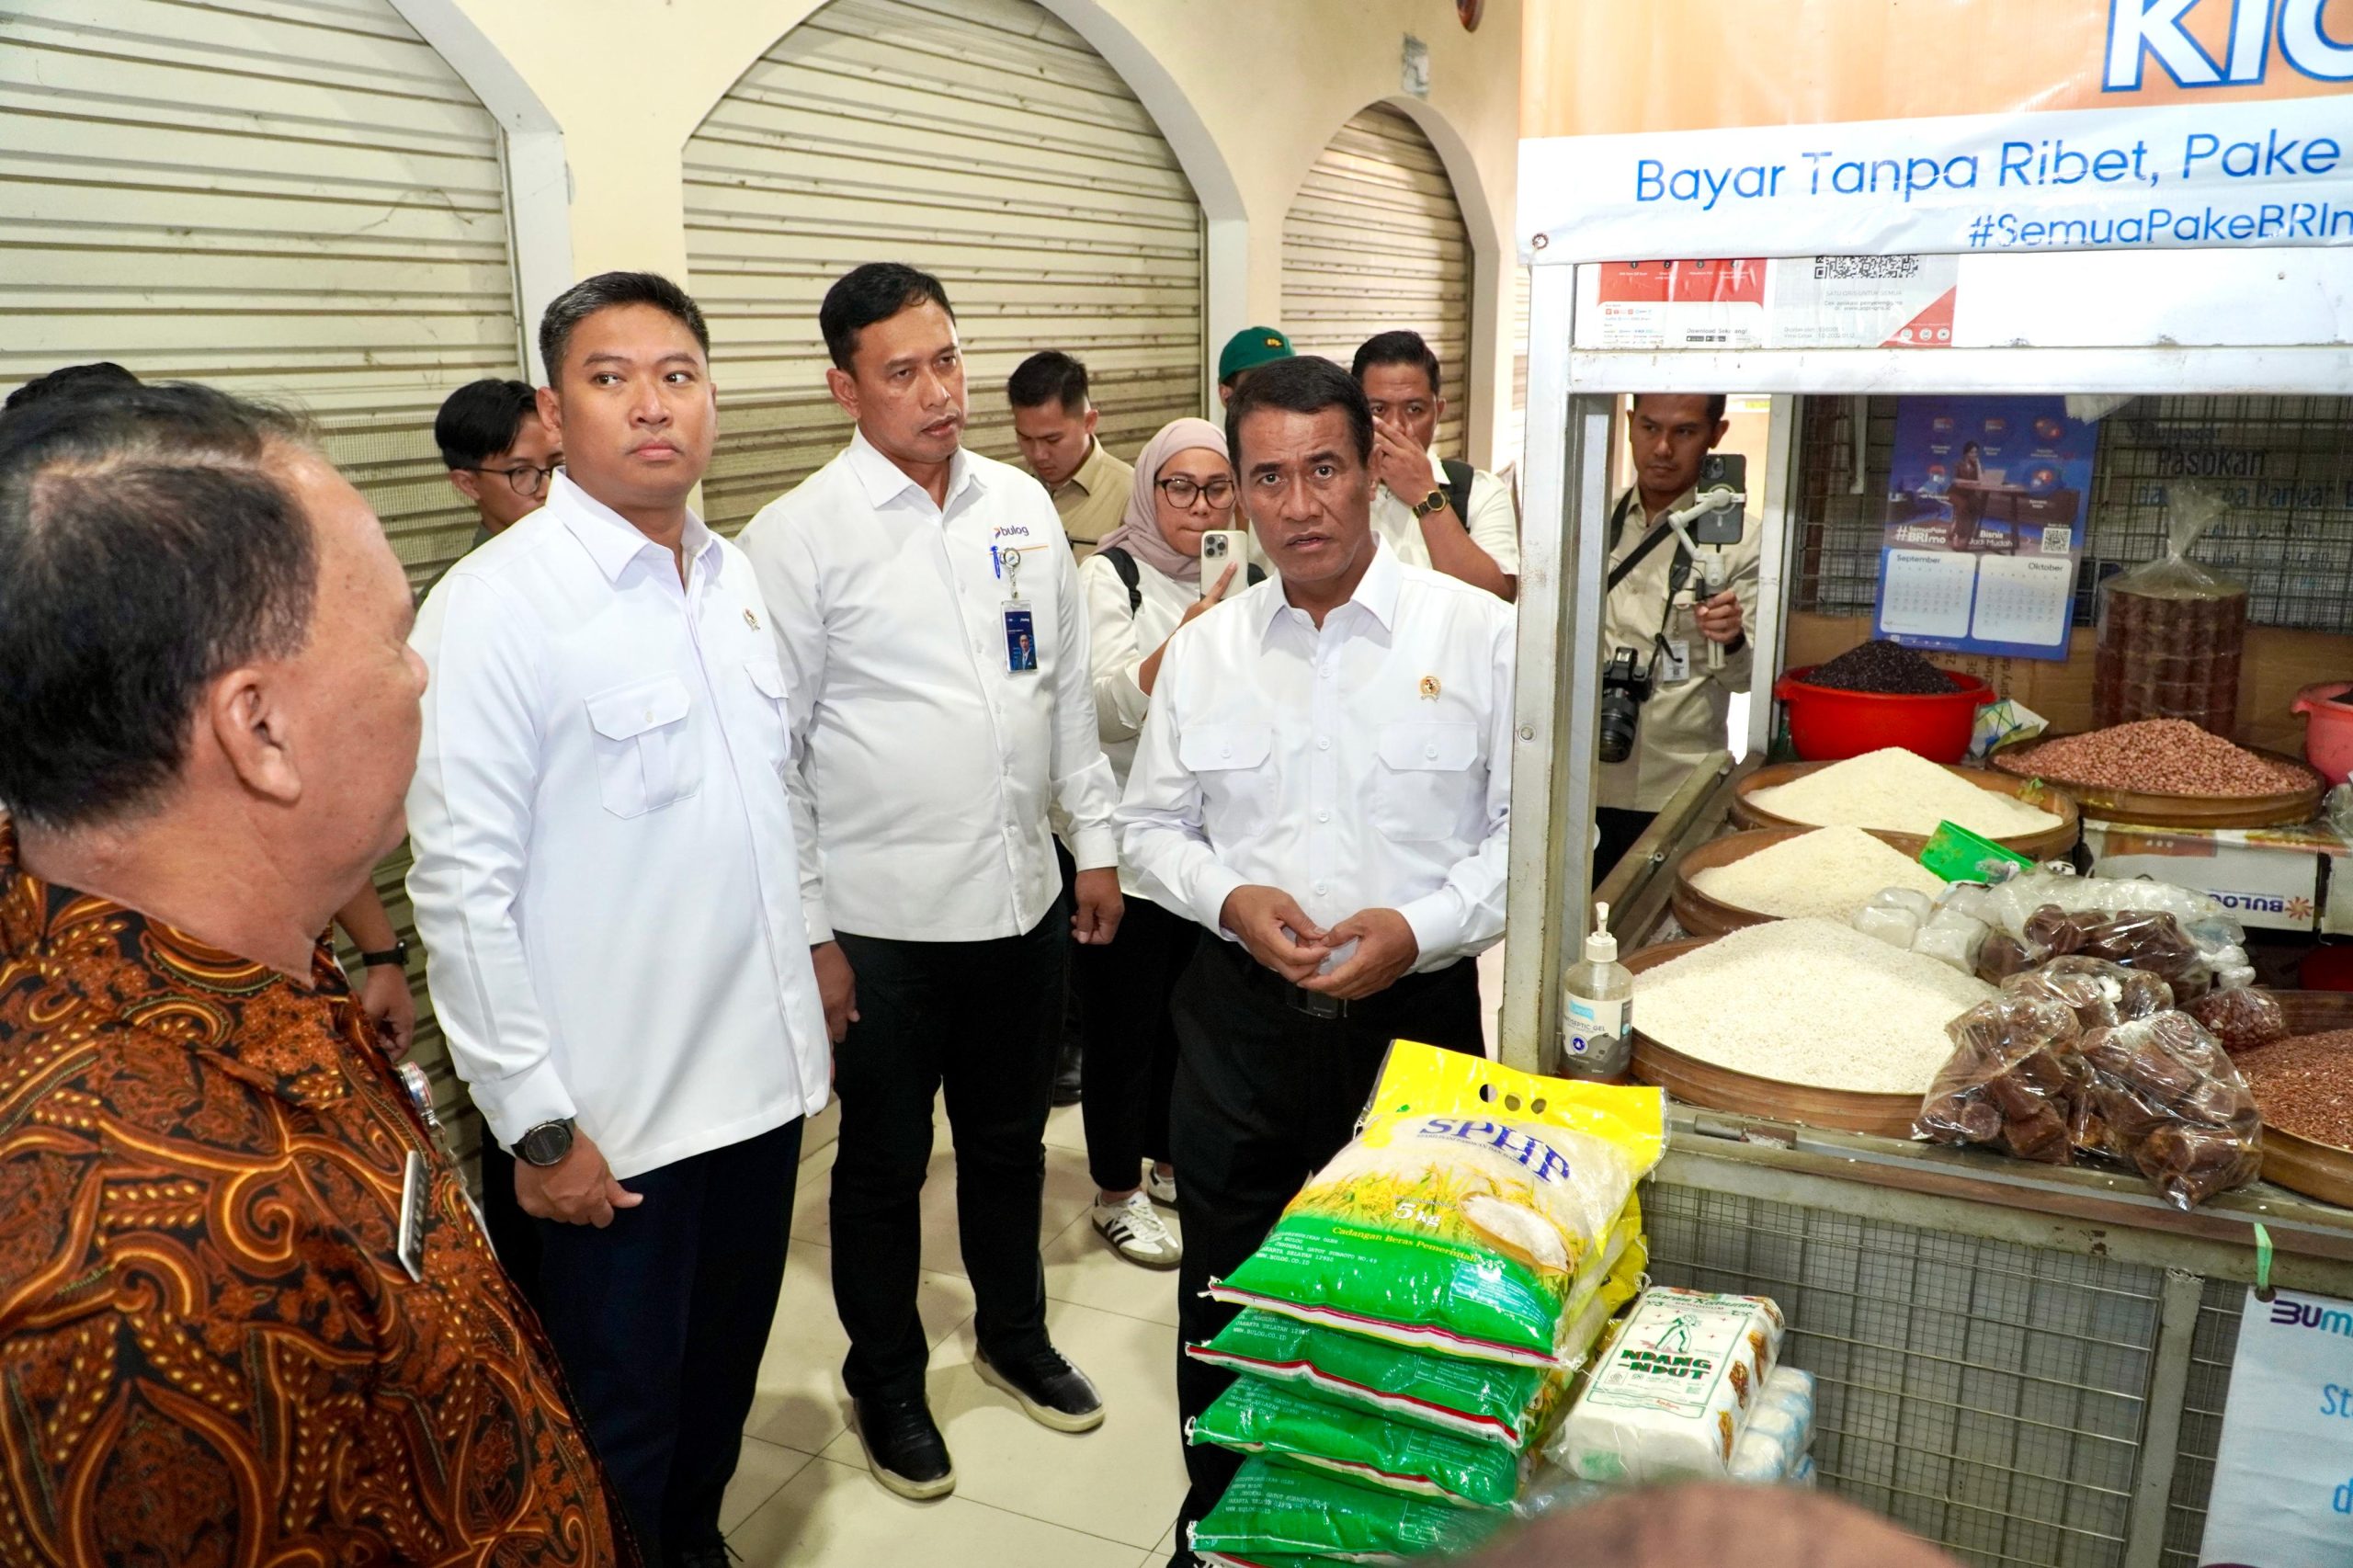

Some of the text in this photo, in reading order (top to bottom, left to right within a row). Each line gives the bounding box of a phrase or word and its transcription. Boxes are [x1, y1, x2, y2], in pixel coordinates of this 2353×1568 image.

[1636, 129, 2341, 210] Bayar Tanpa Ribet, Pake
[1000, 526, 1029, 536] bulog
[1980, 529, 2004, 540] Bisnis
[1908, 533, 1947, 544] BRImo
[1896, 555, 1941, 564] September
[2028, 562, 2063, 572] Oktober
[1419, 1119, 1570, 1183] SPHP
[1393, 1202, 1417, 1219] 5
[1415, 1210, 1442, 1228] kg
[1332, 1226, 1477, 1263] Cadangan Beras Pemerintah
[1256, 1253, 1311, 1267] WWW.BULOG.CO.ID
[1286, 1250, 1313, 1259] SELATAN
[1233, 1326, 1287, 1341] WWW.BULOG.CO.ID
[1262, 1324, 1289, 1333] SELATAN
[1620, 1349, 1713, 1370] NDANG
[2320, 1382, 2353, 1418] St
